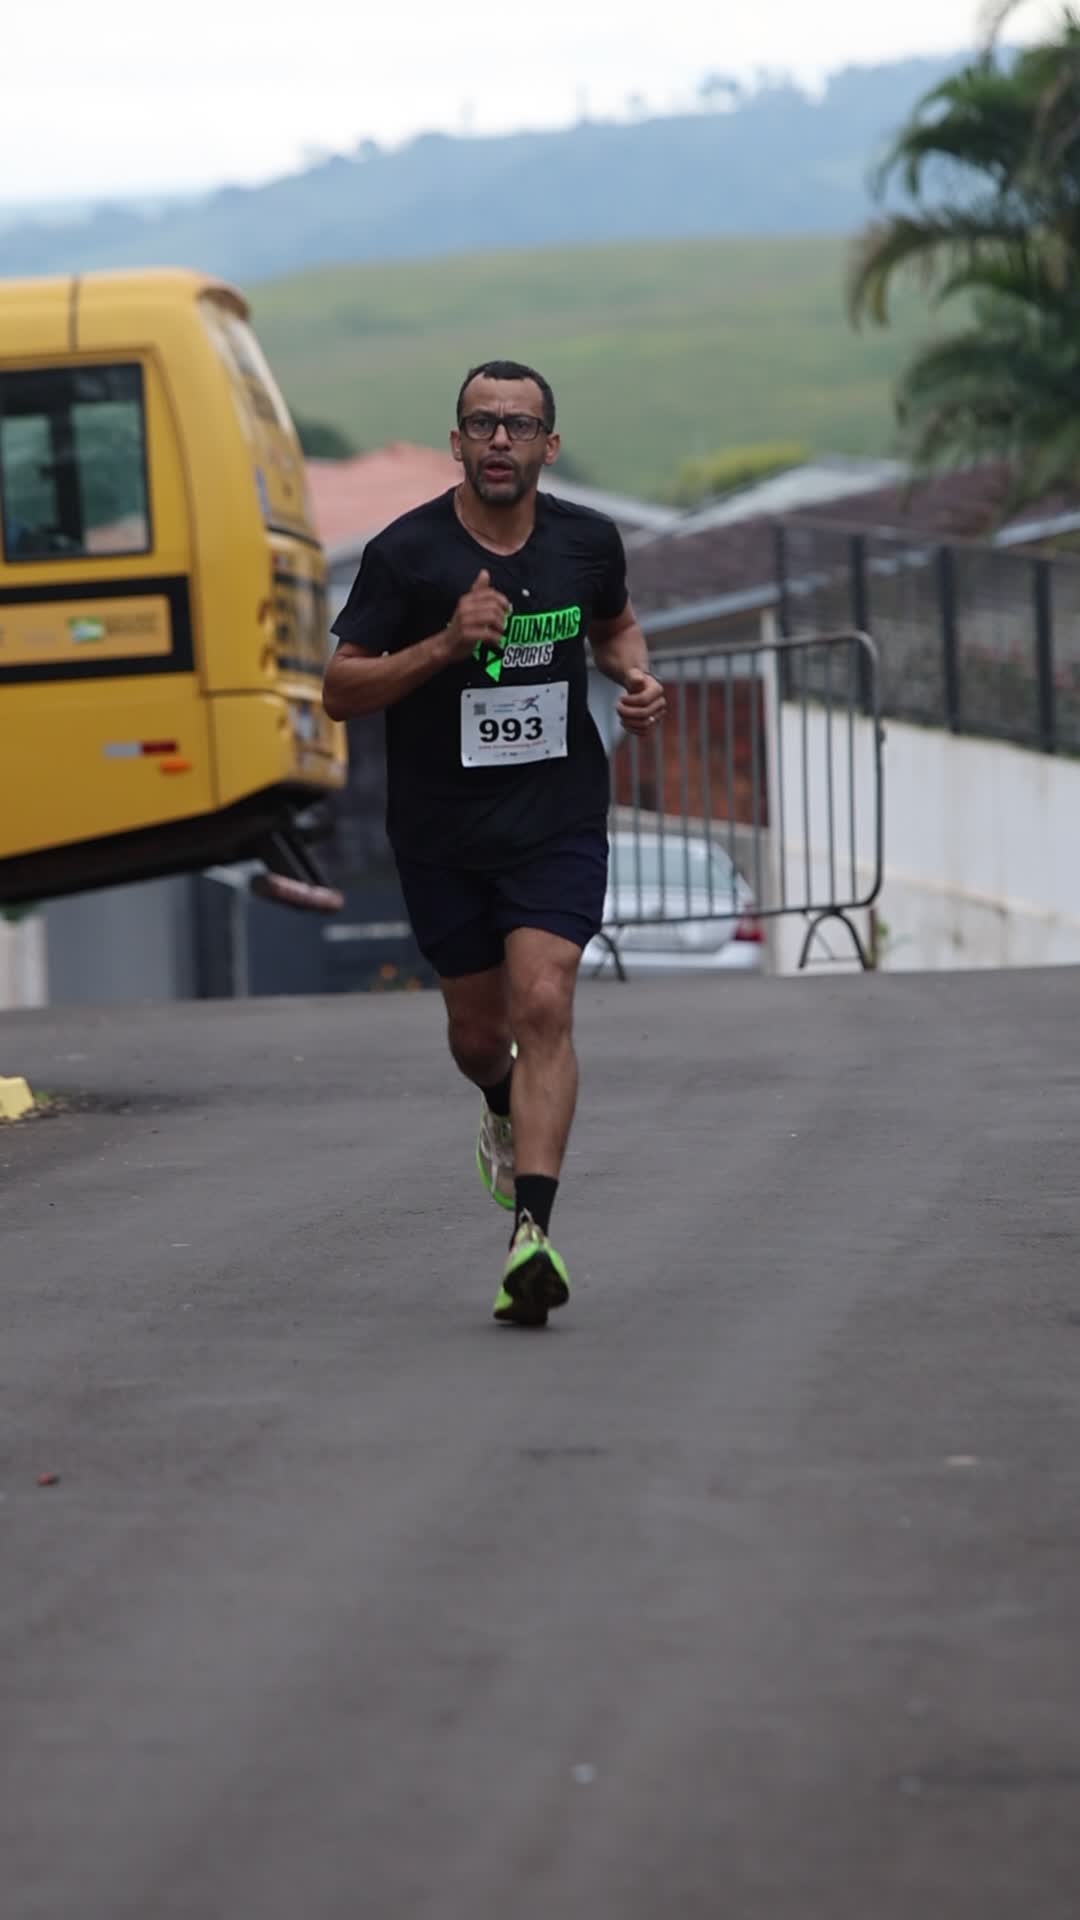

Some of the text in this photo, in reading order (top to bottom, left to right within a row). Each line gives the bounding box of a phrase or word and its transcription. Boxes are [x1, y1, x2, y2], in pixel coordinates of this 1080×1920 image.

[509, 608, 580, 643] DUNAMIS
[503, 643, 554, 666] SPORTS
[479, 716, 543, 743] 993
